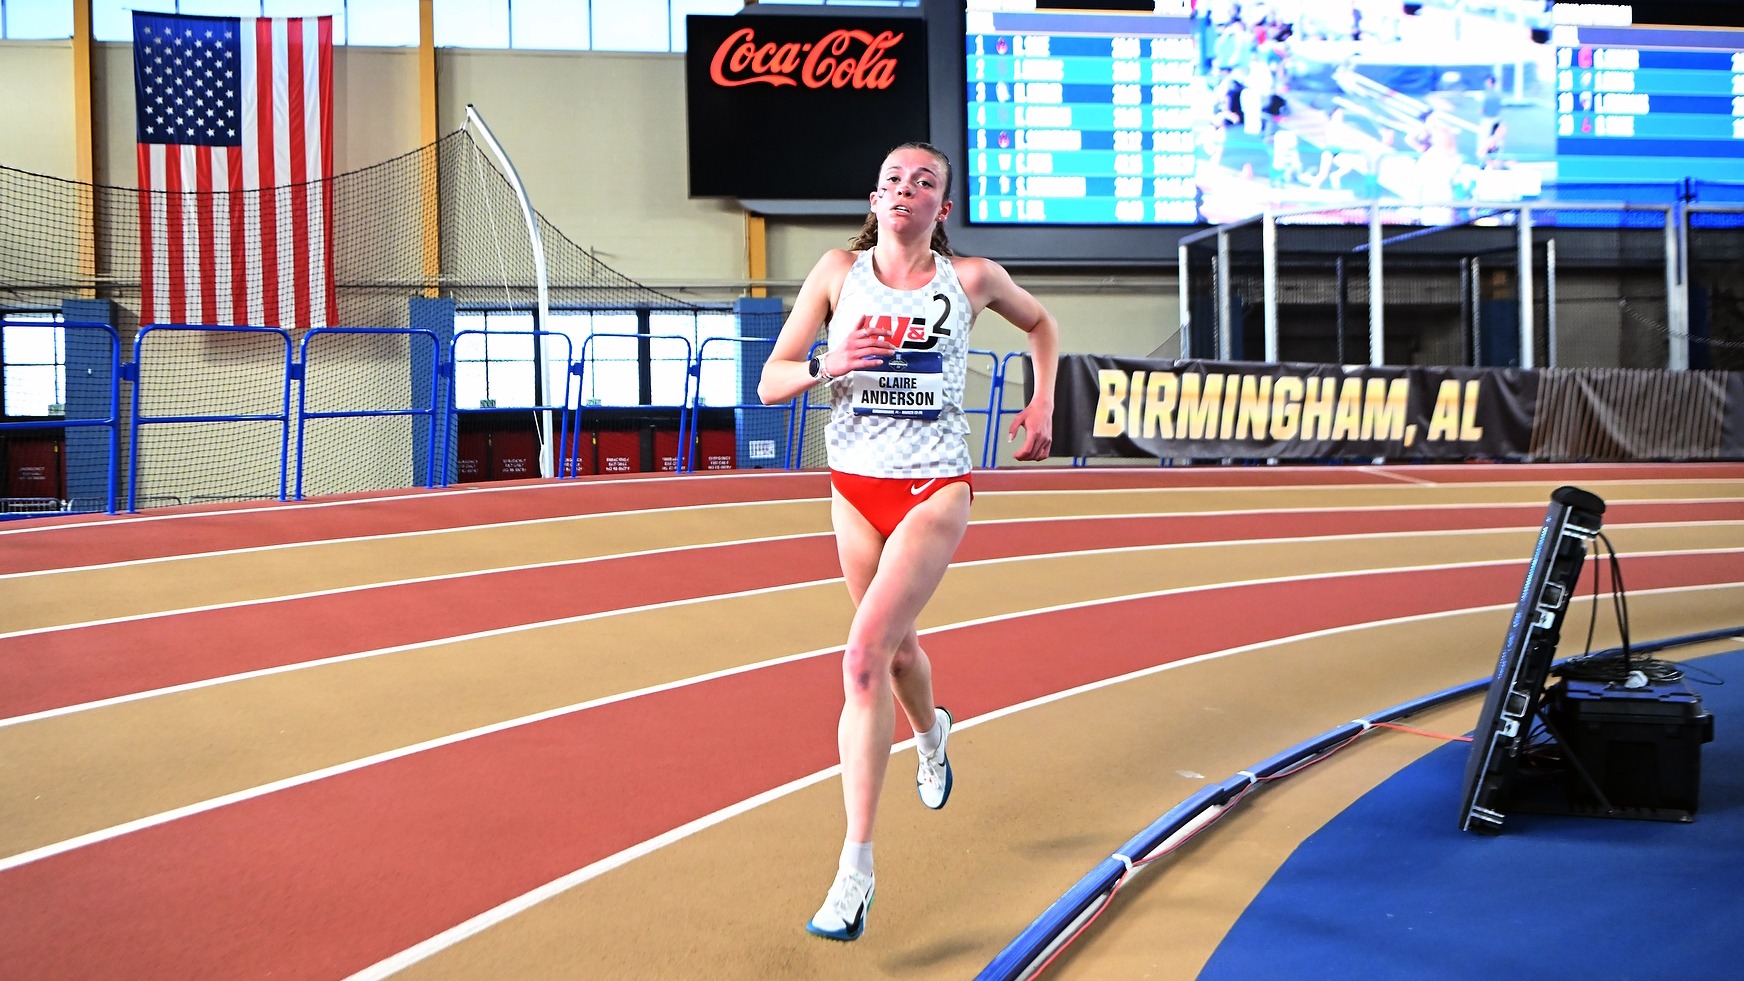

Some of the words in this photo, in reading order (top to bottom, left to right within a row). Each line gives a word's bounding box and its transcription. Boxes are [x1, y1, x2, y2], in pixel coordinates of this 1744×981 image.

[709, 27, 904, 90] Coca-Cola
[932, 293, 951, 336] 2
[861, 389, 934, 406] ANDERSON
[878, 376, 918, 389] CLAIRE
[1093, 369, 1418, 448] BIRMINGHAM,
[1427, 379, 1484, 441] AL
